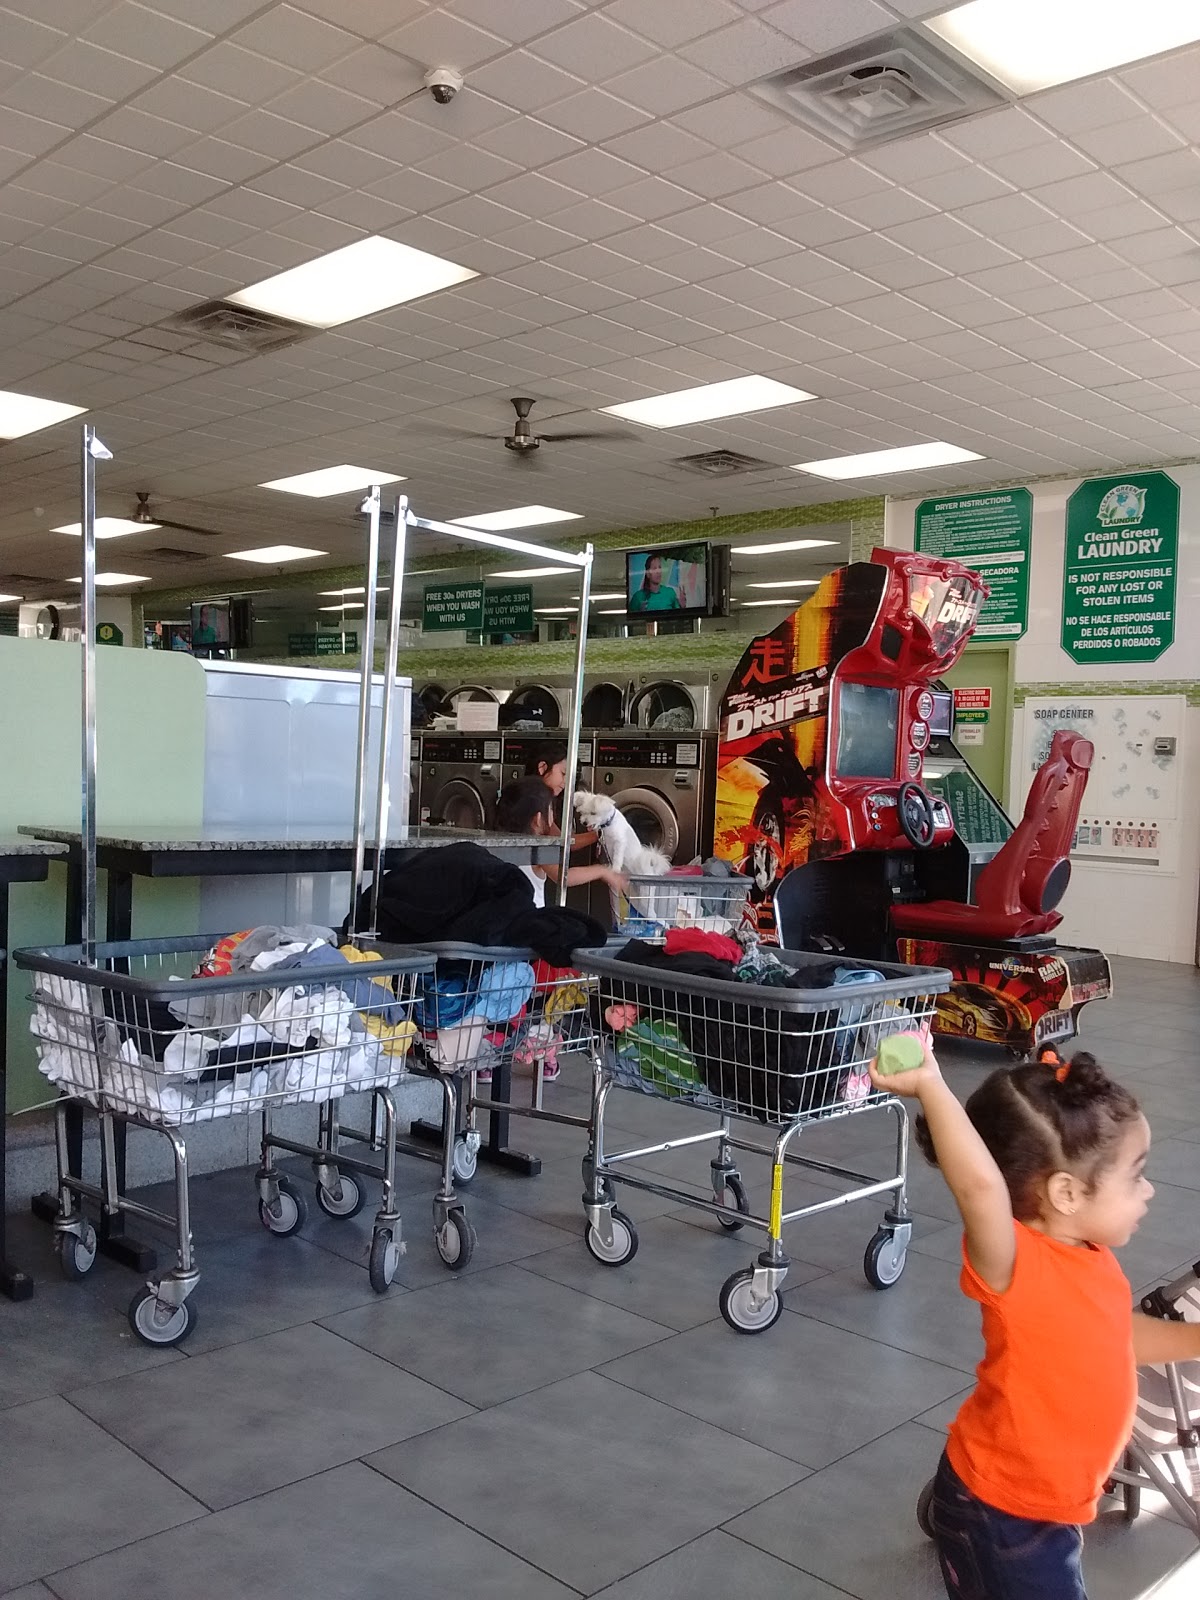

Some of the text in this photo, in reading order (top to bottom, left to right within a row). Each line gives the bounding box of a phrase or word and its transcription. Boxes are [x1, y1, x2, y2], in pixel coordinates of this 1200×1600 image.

[935, 496, 1012, 511] DRYER INSTRUCTIONS
[1101, 491, 1115, 512] CLEAN
[1104, 516, 1141, 525] LAUNDRY
[1084, 528, 1159, 542] Clean Green
[1078, 538, 1163, 559] LAUNDRY
[980, 567, 1019, 576] SECADORA
[1068, 567, 1173, 583] IS NOT RESPONSIBLE
[1076, 581, 1163, 595] FOR ANY LOST OR
[426, 592, 442, 601] FREE
[456, 589, 481, 599] DRYERS
[1083, 594, 1154, 607] STOLEN ITEMS
[426, 601, 480, 612] WHEN YOU WASH
[439, 613, 466, 623] WITH US
[1066, 612, 1171, 625] NO SE HACE RESPONSABLE
[1081, 624, 1154, 637] DE LOS ARTÍCULOS
[1073, 637, 1161, 649] PERDIDOS O ROBADOS
[727, 687, 825, 741] DRIFT
[1036, 710, 1094, 718] SOAP CENTER
[989, 962, 1035, 974] UNIVERSAL
[1038, 960, 1062, 976] RAW
[1038, 1013, 1070, 1040] DRIFT
